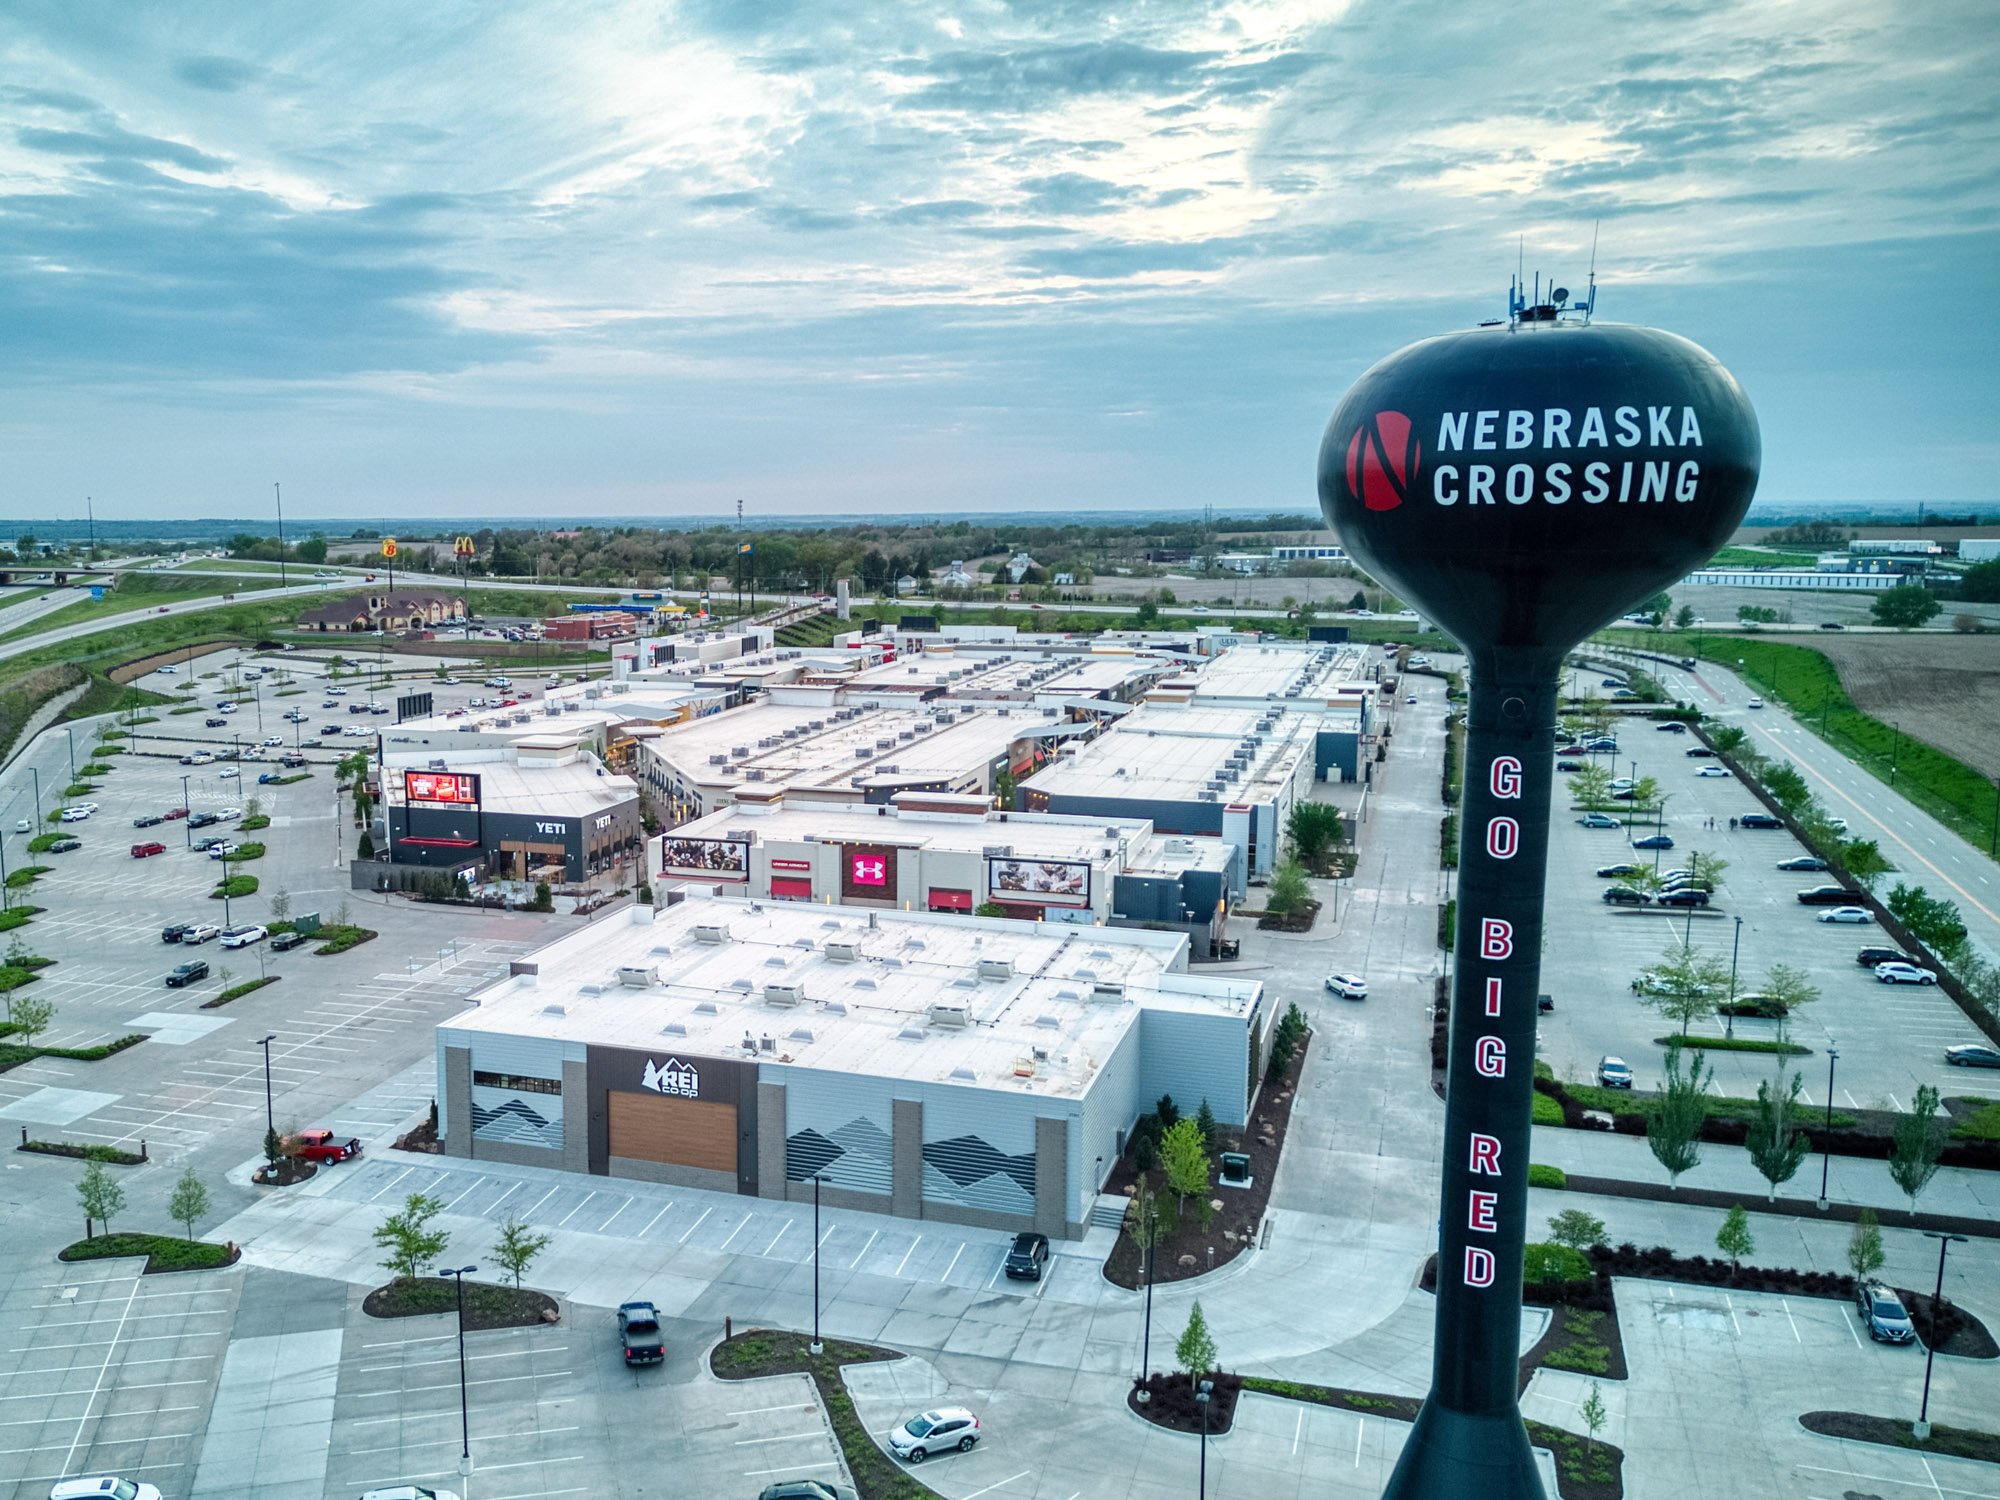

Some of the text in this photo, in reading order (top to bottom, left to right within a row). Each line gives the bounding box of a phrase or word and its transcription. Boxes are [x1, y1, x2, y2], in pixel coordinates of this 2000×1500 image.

[1437, 406, 1703, 451] NEBRASKA
[1434, 460, 1700, 506] CROSSING
[536, 822, 566, 834] YETI
[596, 815, 611, 829] YETI
[1463, 755, 1522, 1288] GO BIG RED
[662, 1071, 698, 1089] REI
